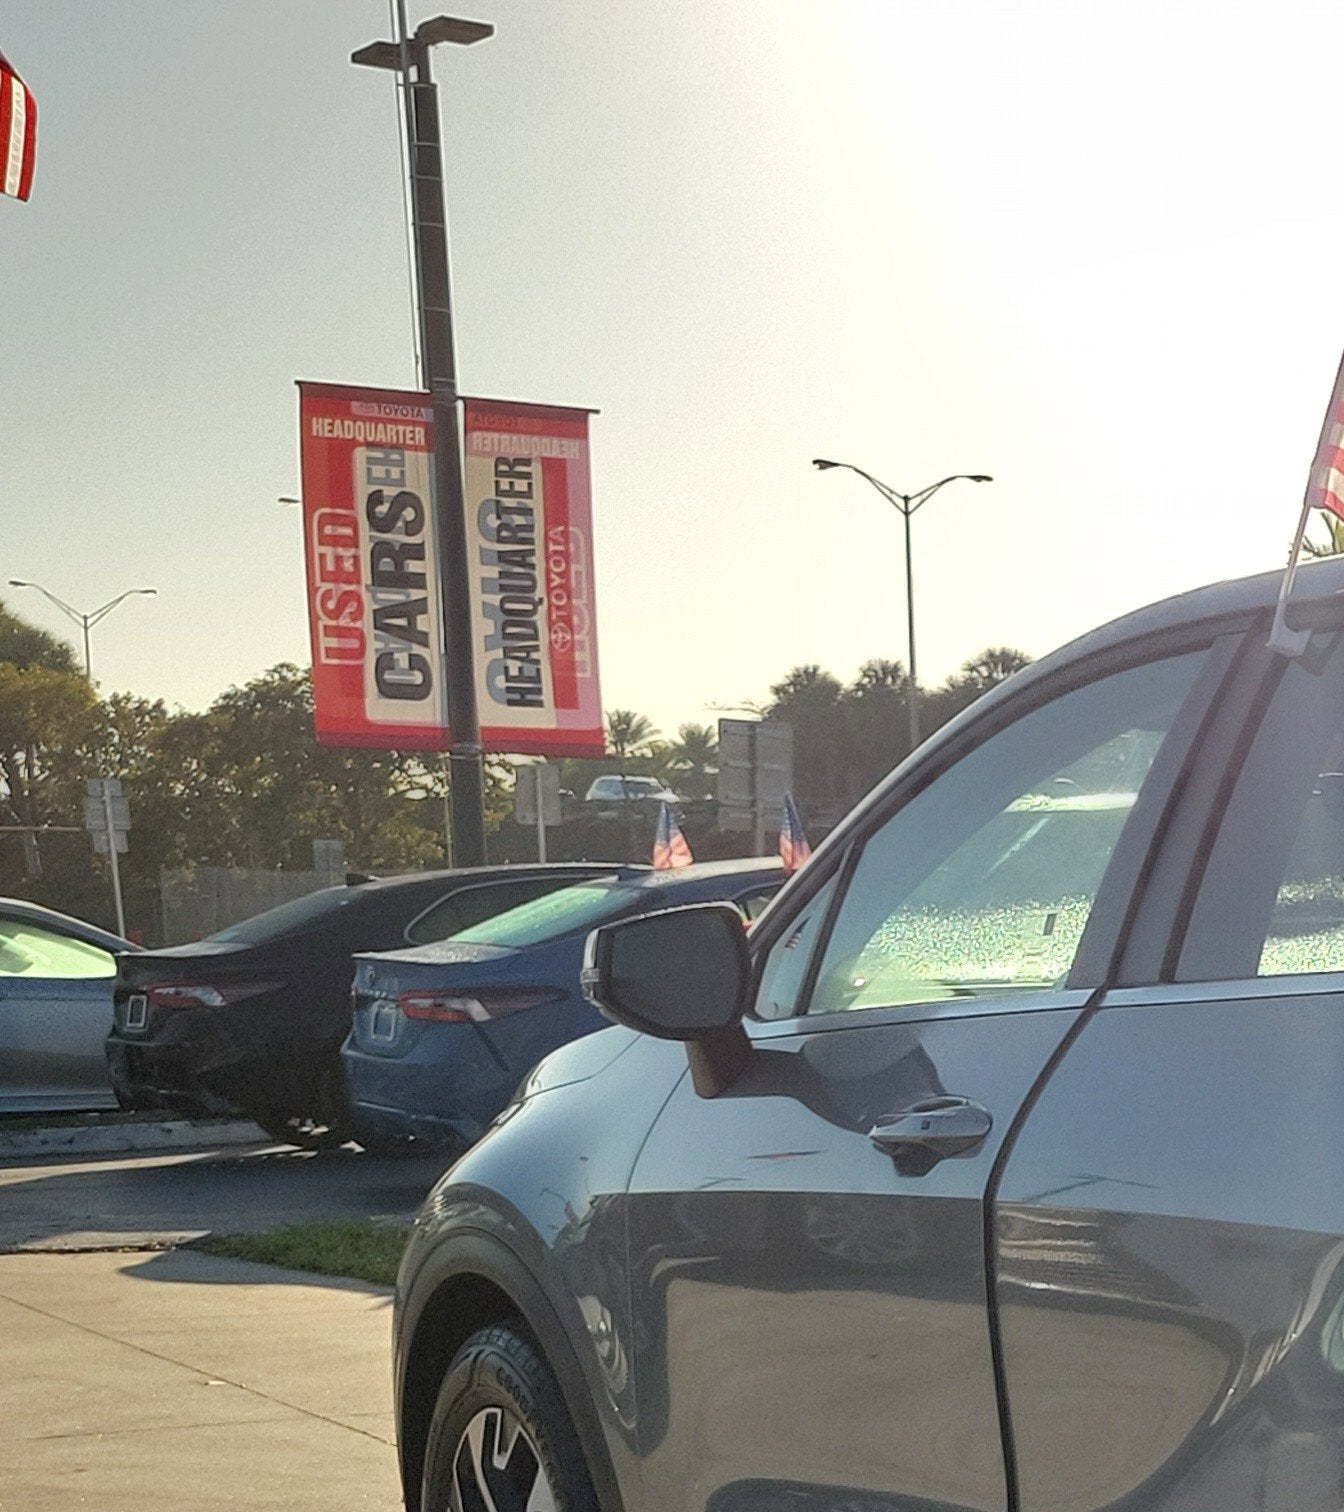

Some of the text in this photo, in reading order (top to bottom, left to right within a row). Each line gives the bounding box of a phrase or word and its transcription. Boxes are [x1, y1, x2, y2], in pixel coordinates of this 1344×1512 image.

[312, 416, 426, 446] HEADQUARTER
[376, 404, 425, 419] TOYOTA
[313, 507, 366, 665] USED
[366, 489, 433, 702] CARS
[494, 456, 545, 708] HEADQUARTER
[548, 525, 568, 621] TOYOTA
